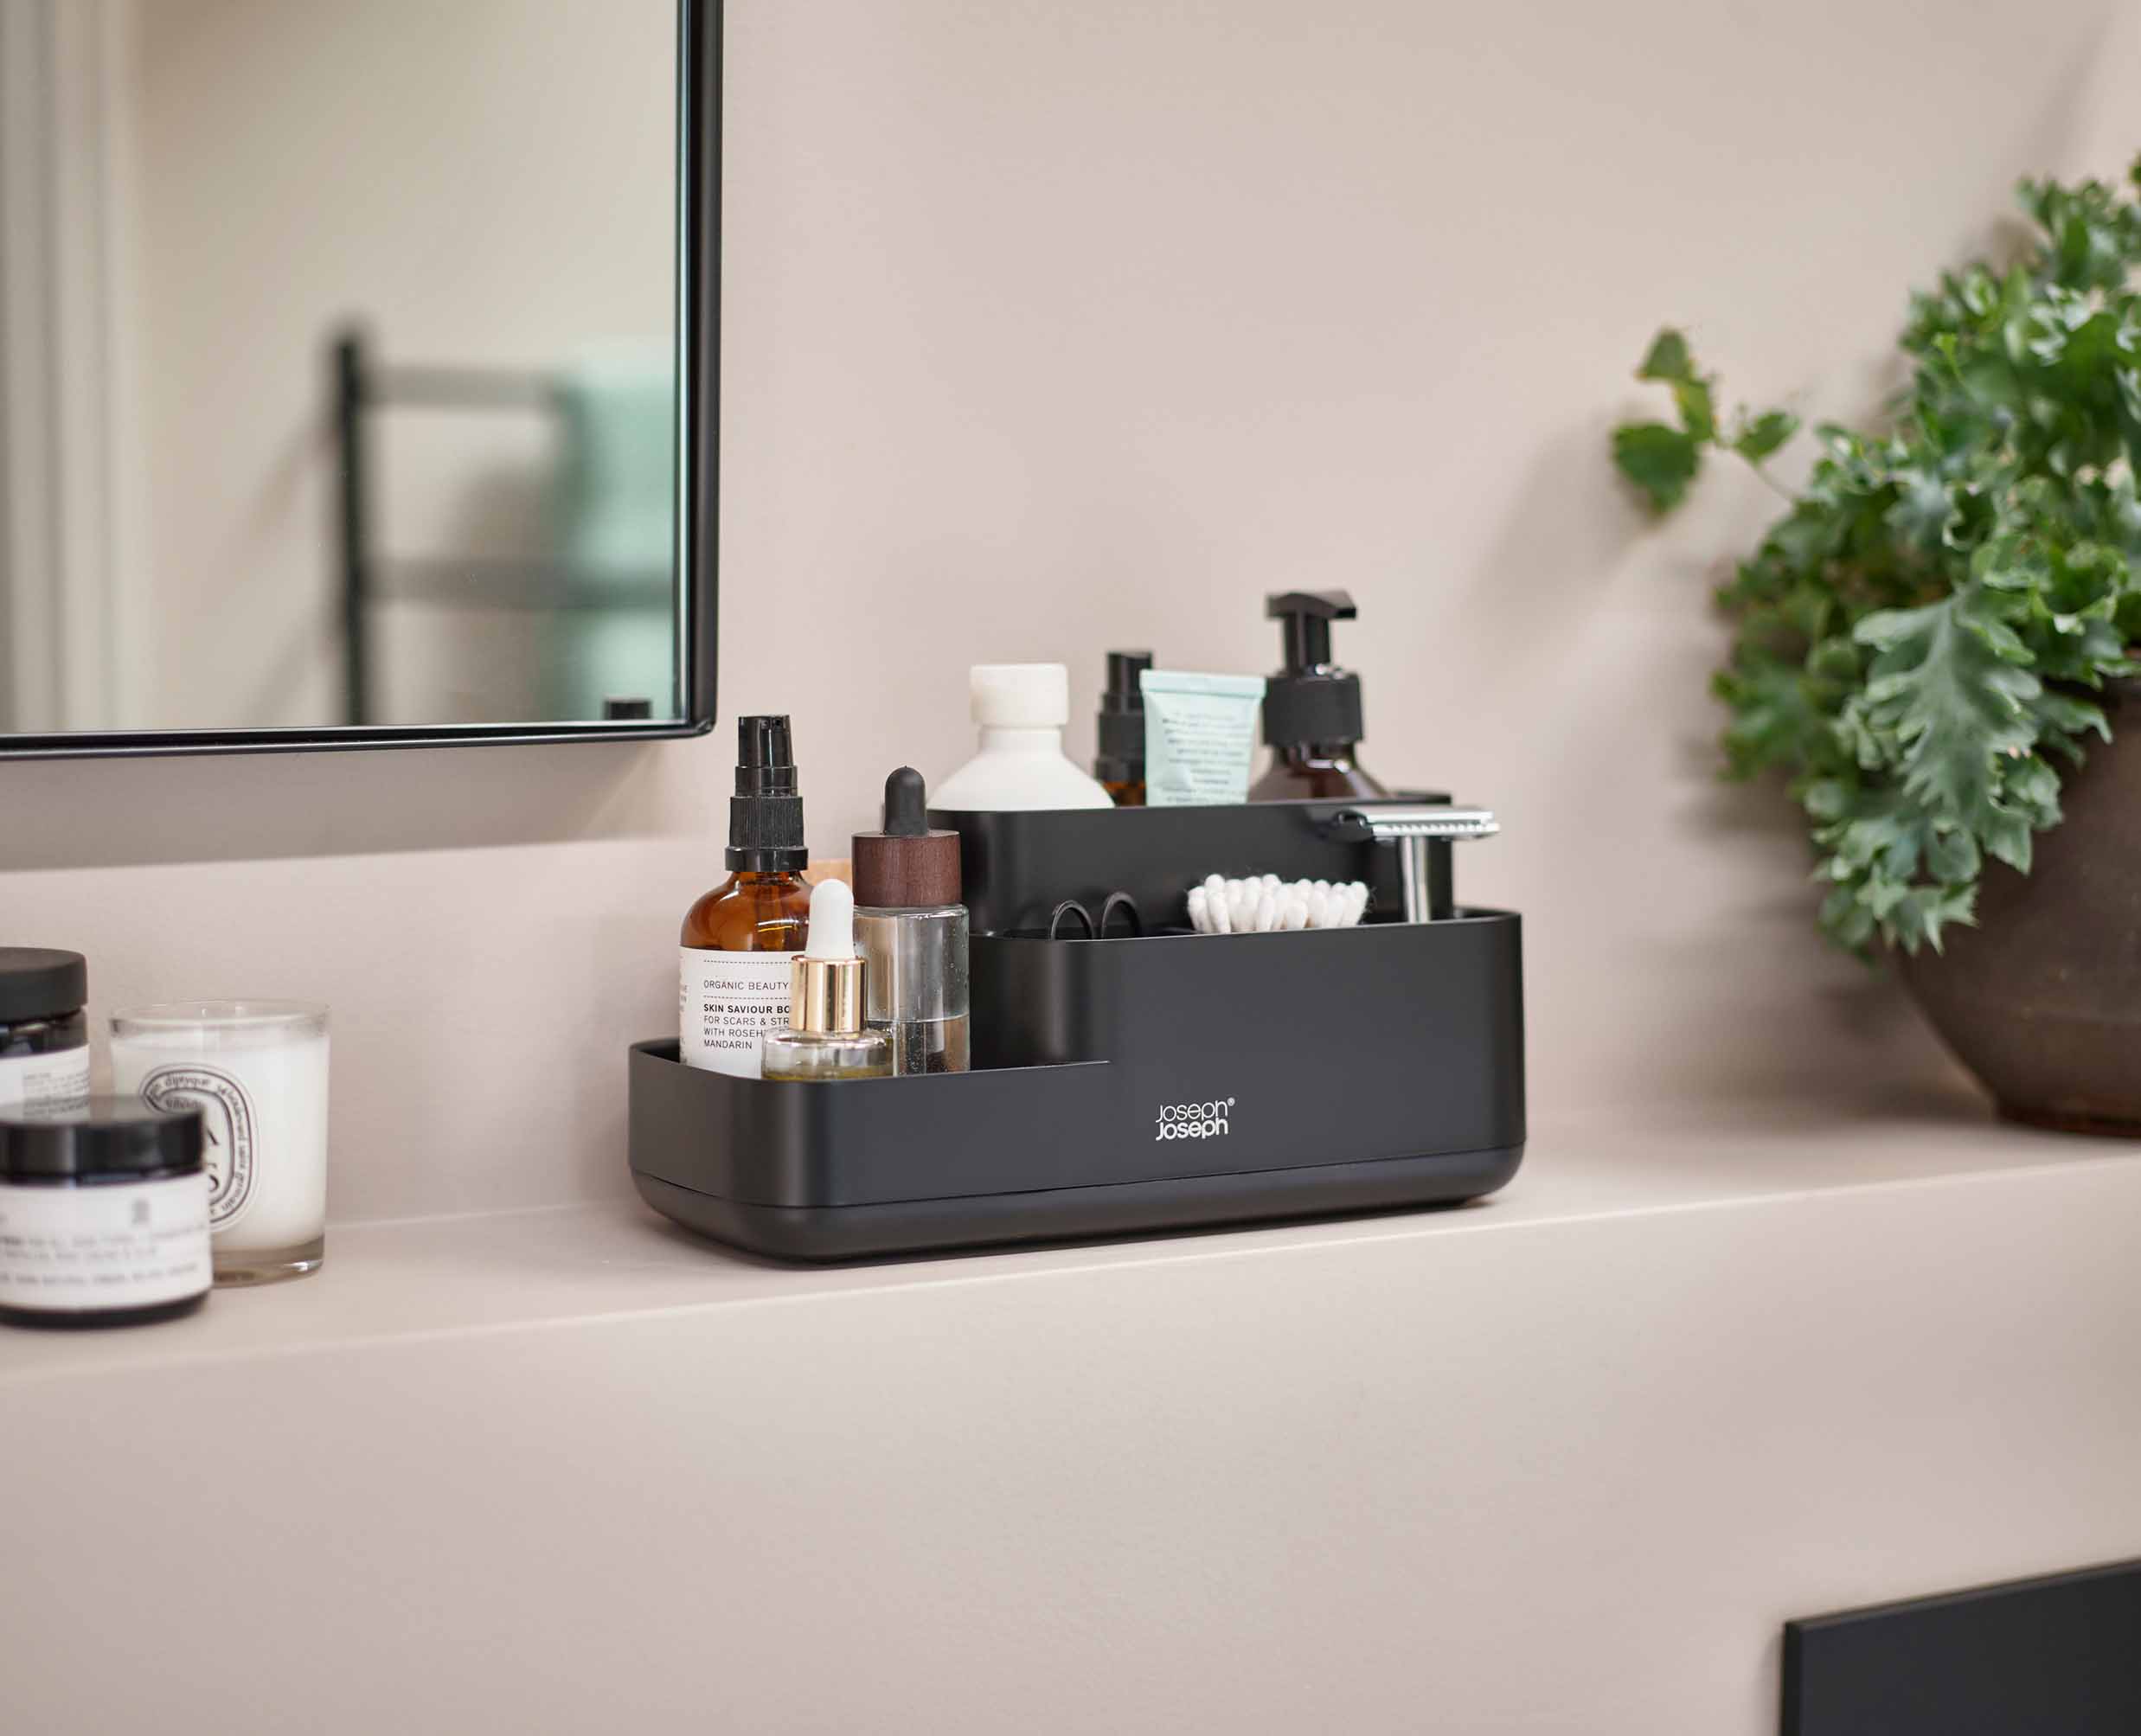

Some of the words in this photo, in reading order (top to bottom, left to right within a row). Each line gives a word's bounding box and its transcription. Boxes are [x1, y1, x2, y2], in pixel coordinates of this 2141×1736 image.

[703, 979, 744, 990] ORGANIC
[748, 982, 789, 990] BEAUTY
[703, 1003, 724, 1013] SKIN
[728, 1004, 772, 1014] SAVIOUR
[776, 1005, 790, 1014] BO
[703, 1015, 720, 1024] FOR
[723, 1016, 755, 1026] SCARS
[760, 1017, 766, 1026] &
[770, 1017, 789, 1026] STR
[703, 1027, 725, 1036] WITH
[728, 1028, 765, 1038] ROSEH
[703, 1039, 753, 1049] MANDARIN
[1156, 1118, 1228, 1141] Joseph
